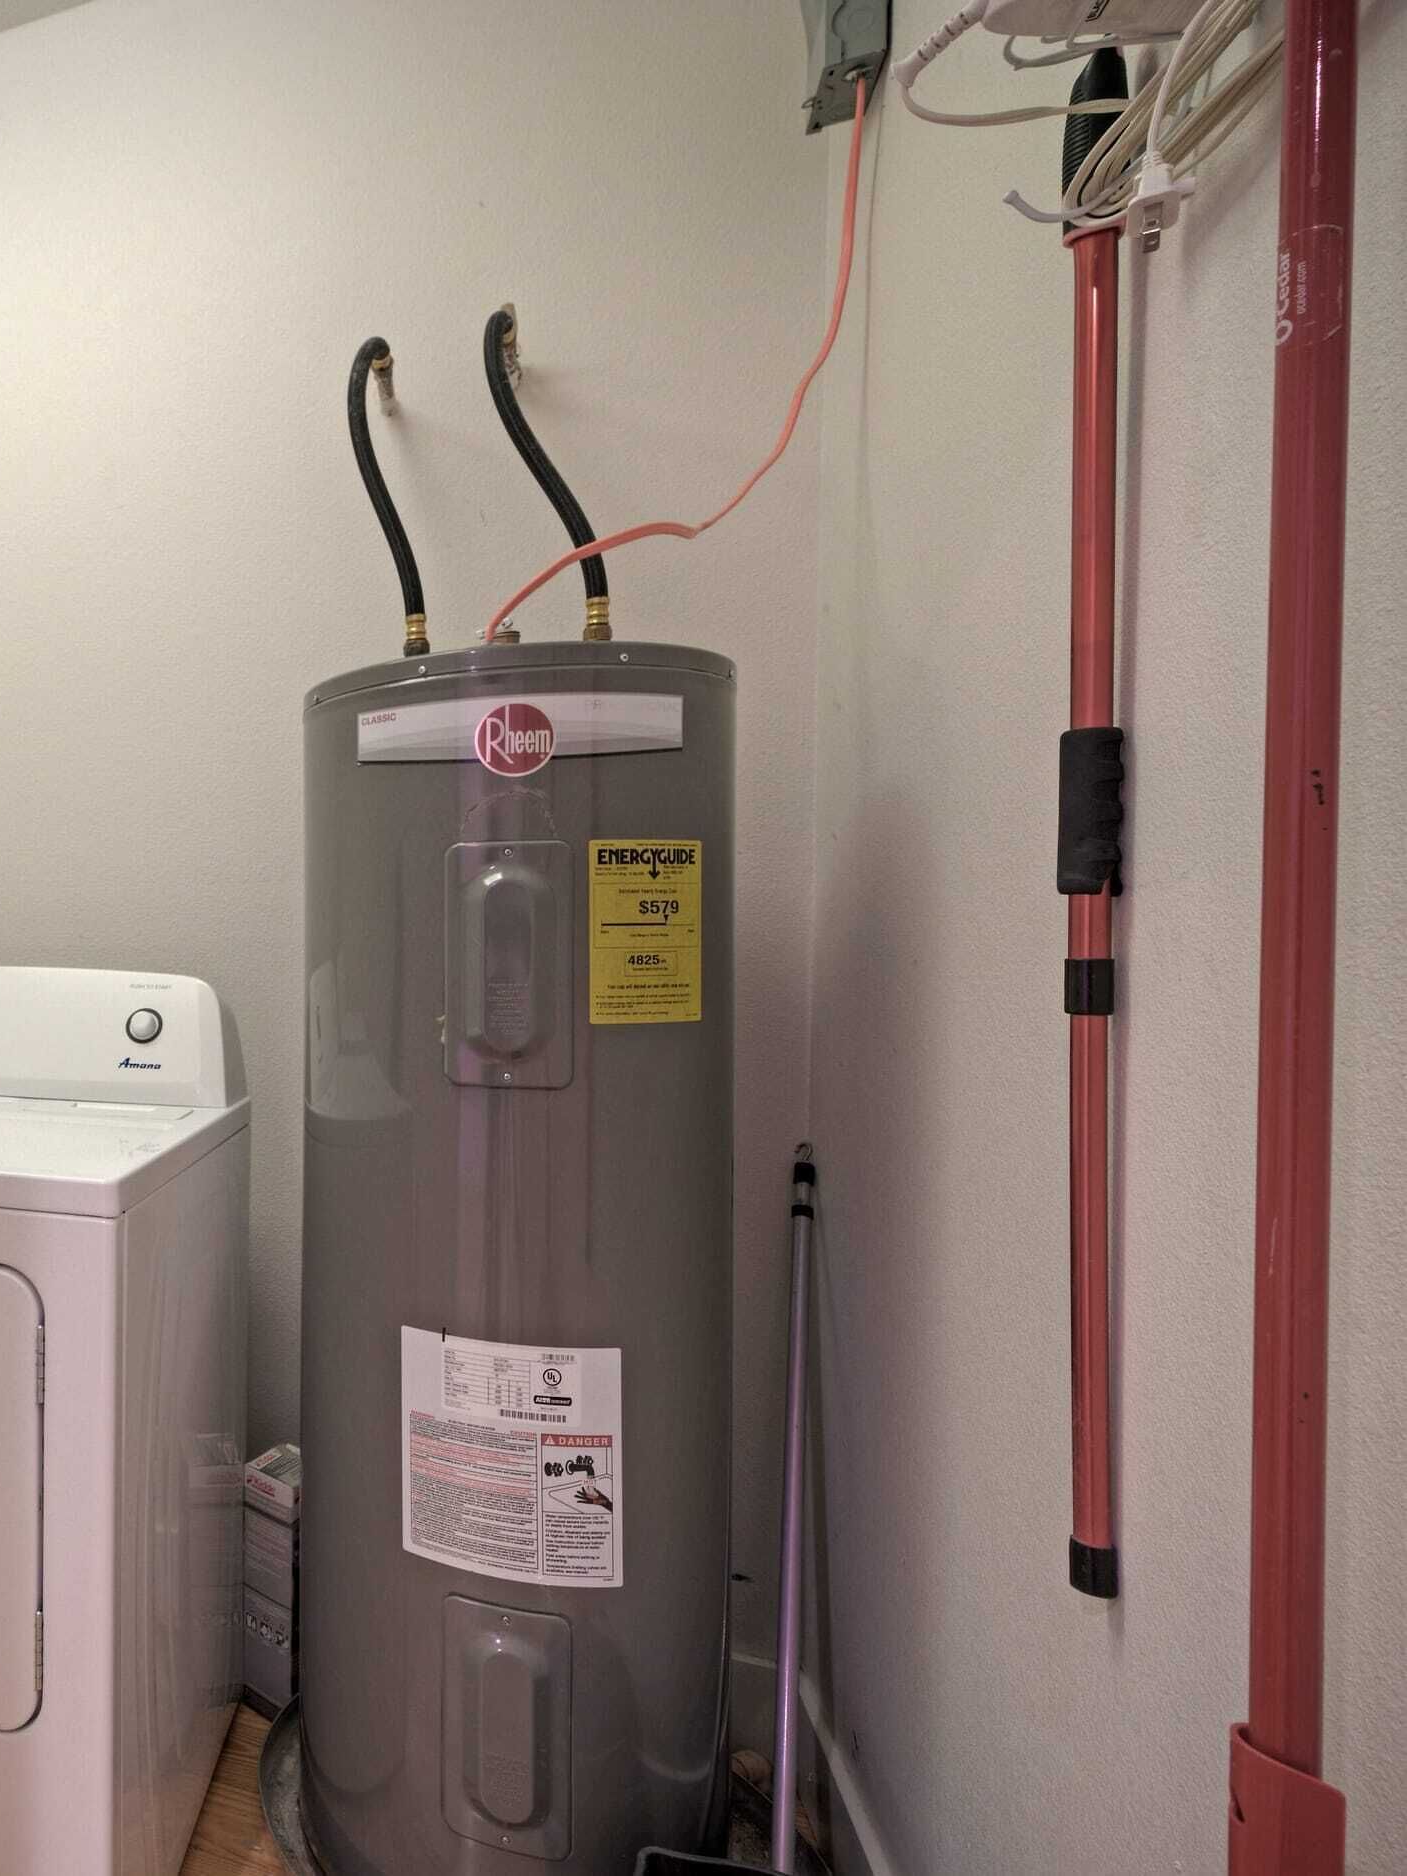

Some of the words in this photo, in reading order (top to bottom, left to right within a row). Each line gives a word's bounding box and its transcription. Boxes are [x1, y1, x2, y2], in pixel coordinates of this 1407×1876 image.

[361, 711, 397, 726] CLASSIC
[485, 704, 551, 764] Rheem
[597, 848, 696, 866] ENERGYGUIDE
[639, 900, 679, 915] $579
[627, 954, 660, 966] 4825
[118, 1056, 162, 1070] Amana
[559, 1436, 609, 1447] DANGER
